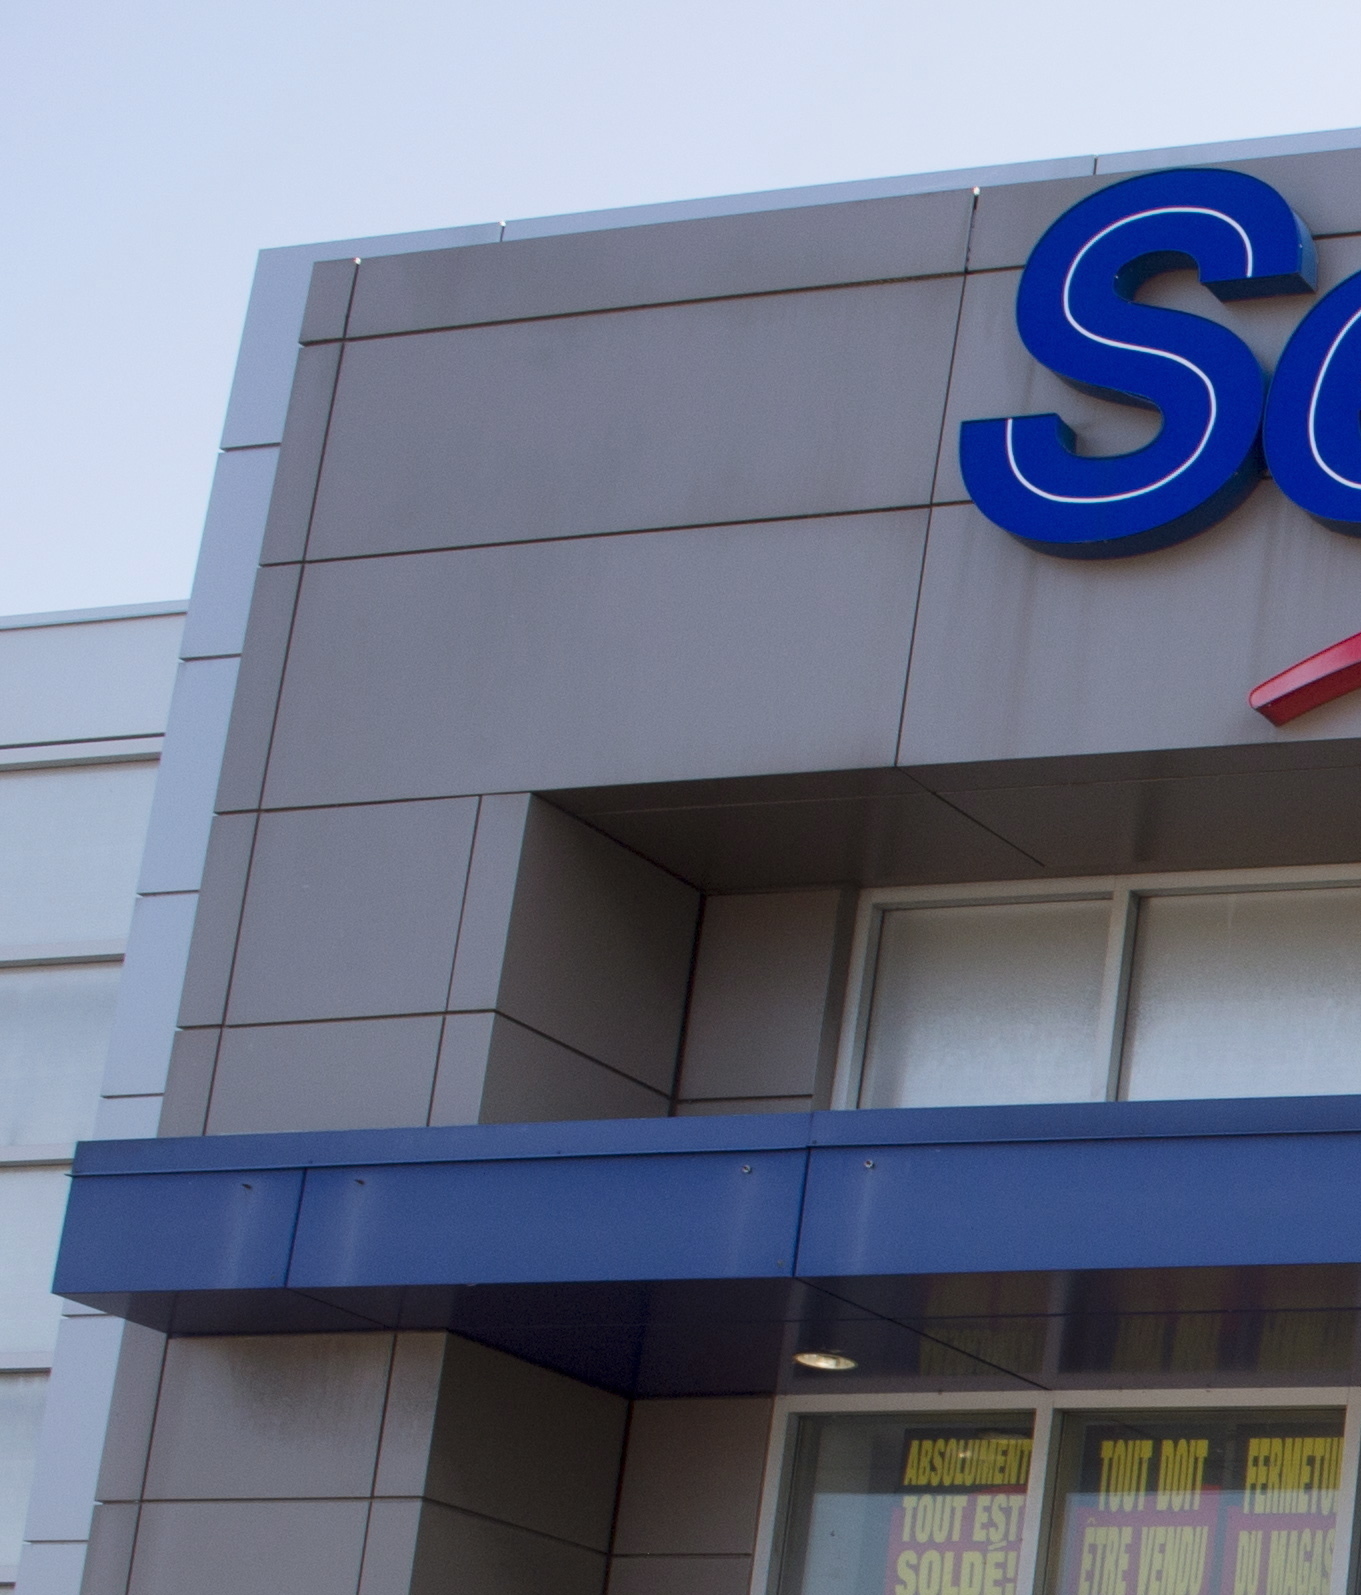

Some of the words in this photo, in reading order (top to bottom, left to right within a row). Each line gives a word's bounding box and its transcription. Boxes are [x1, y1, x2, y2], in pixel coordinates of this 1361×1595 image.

[903, 1438, 1034, 1485] ABSOLUMENT
[1099, 1439, 1153, 1512] TOUT
[1156, 1439, 1208, 1511] DOIT
[1243, 1437, 1344, 1515] FERMETU
[902, 1494, 968, 1543] TOUT
[972, 1494, 1027, 1543] EST
